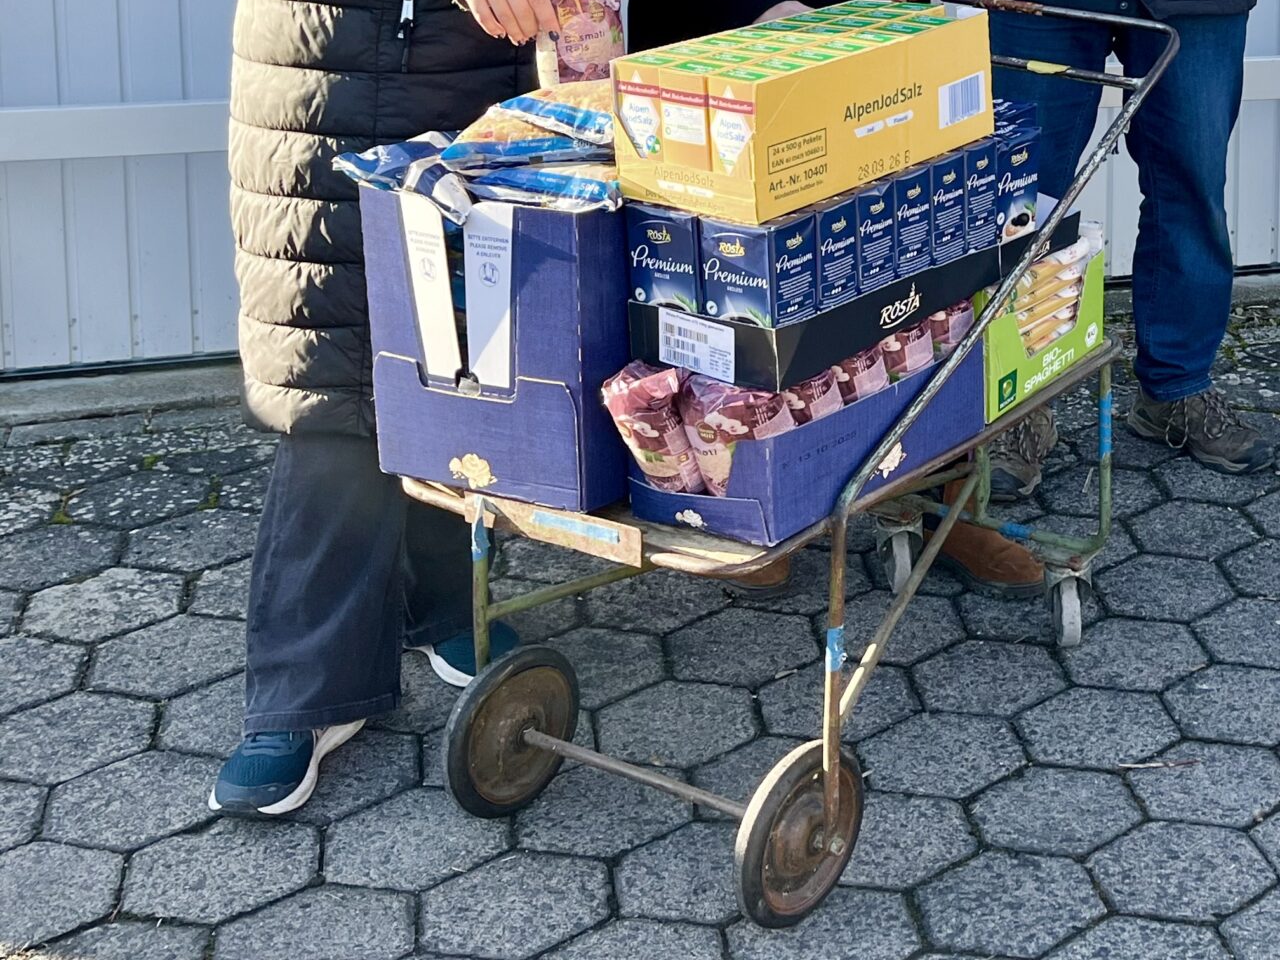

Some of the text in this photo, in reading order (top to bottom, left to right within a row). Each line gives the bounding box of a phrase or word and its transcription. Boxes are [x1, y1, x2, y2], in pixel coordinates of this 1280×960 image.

[843, 82, 923, 123] AlpenJodSalz
[802, 133, 823, 146] Pakete
[768, 162, 829, 193] Art.-Nr. 10401
[967, 174, 996, 190] Premium
[998, 172, 1038, 197] Premium
[933, 188, 964, 206] Premium
[897, 203, 930, 221] Premium
[860, 218, 893, 238] Premium
[821, 236, 855, 257] Premium
[631, 244, 694, 275] Premium
[776, 253, 813, 274] Premium
[703, 257, 769, 290] Premium
[1042, 347, 1062, 368] BIO-
[1024, 348, 1075, 394] SPAGHETTI
